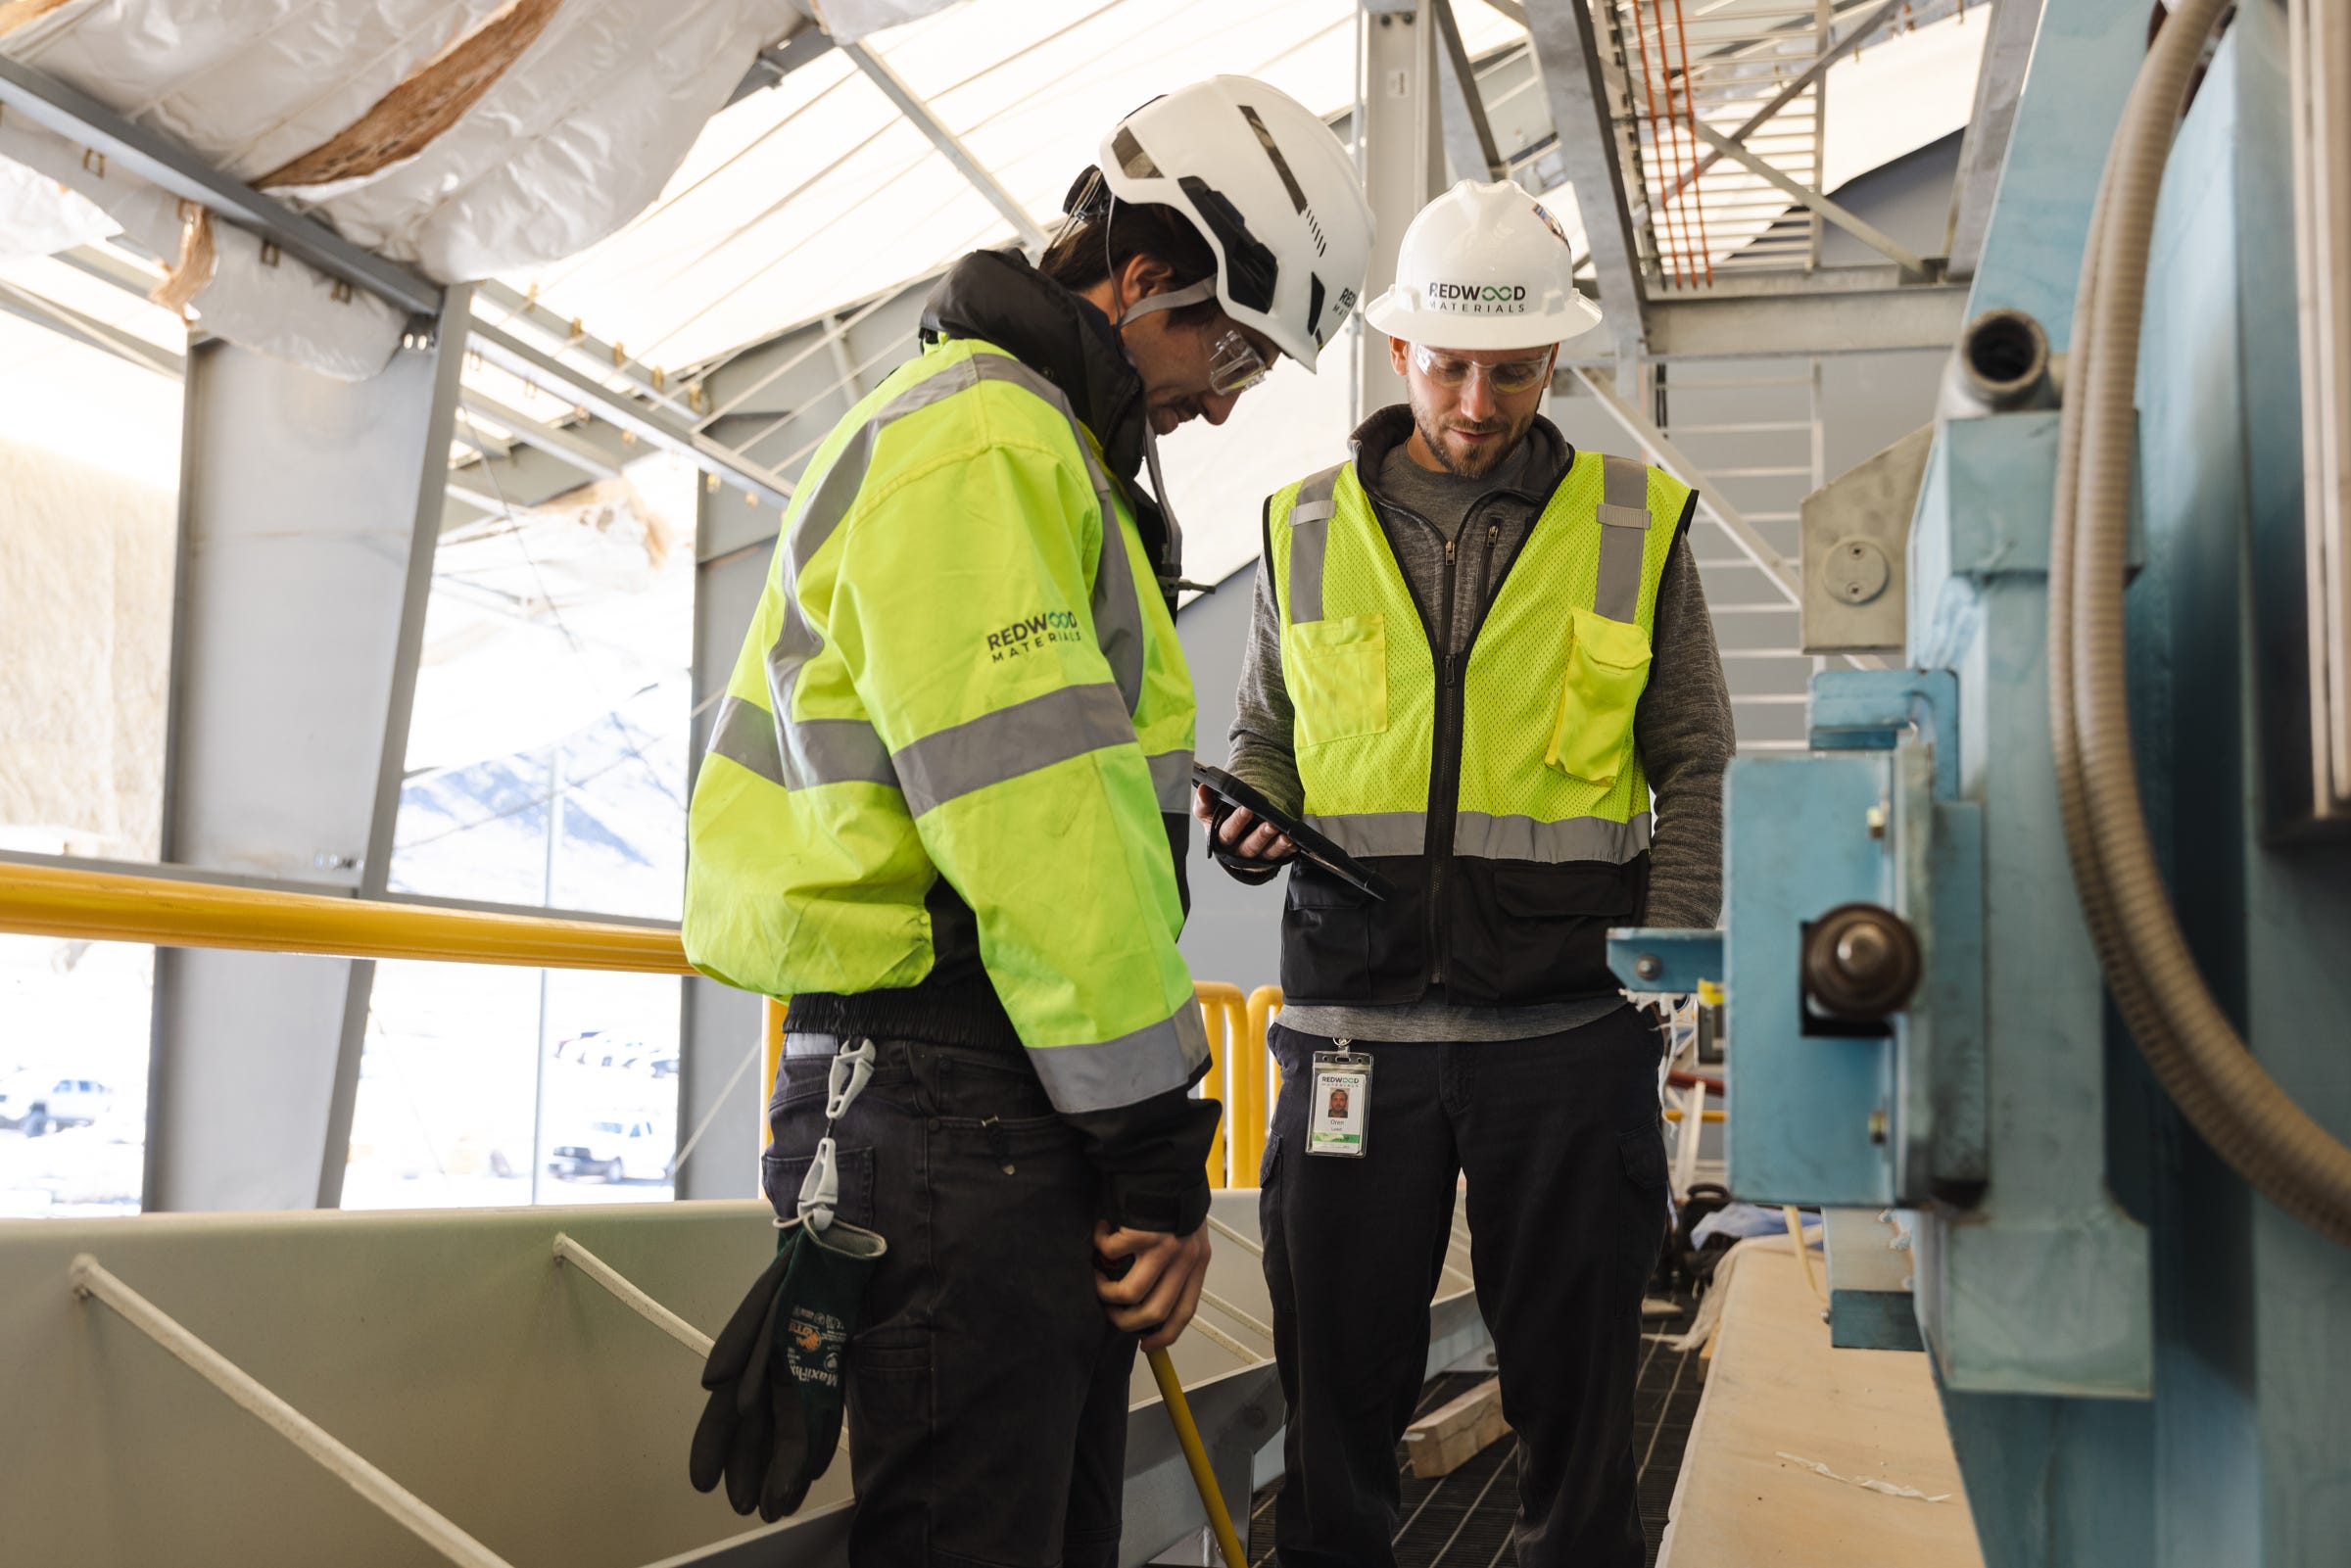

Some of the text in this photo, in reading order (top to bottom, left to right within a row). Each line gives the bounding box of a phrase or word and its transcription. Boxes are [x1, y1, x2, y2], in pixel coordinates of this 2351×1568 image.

[1429, 282, 1526, 302] REDWOOD
[1429, 301, 1524, 313] MATERIALS
[987, 610, 1078, 651] REDWOOD
[992, 631, 1081, 664] MATERIALS
